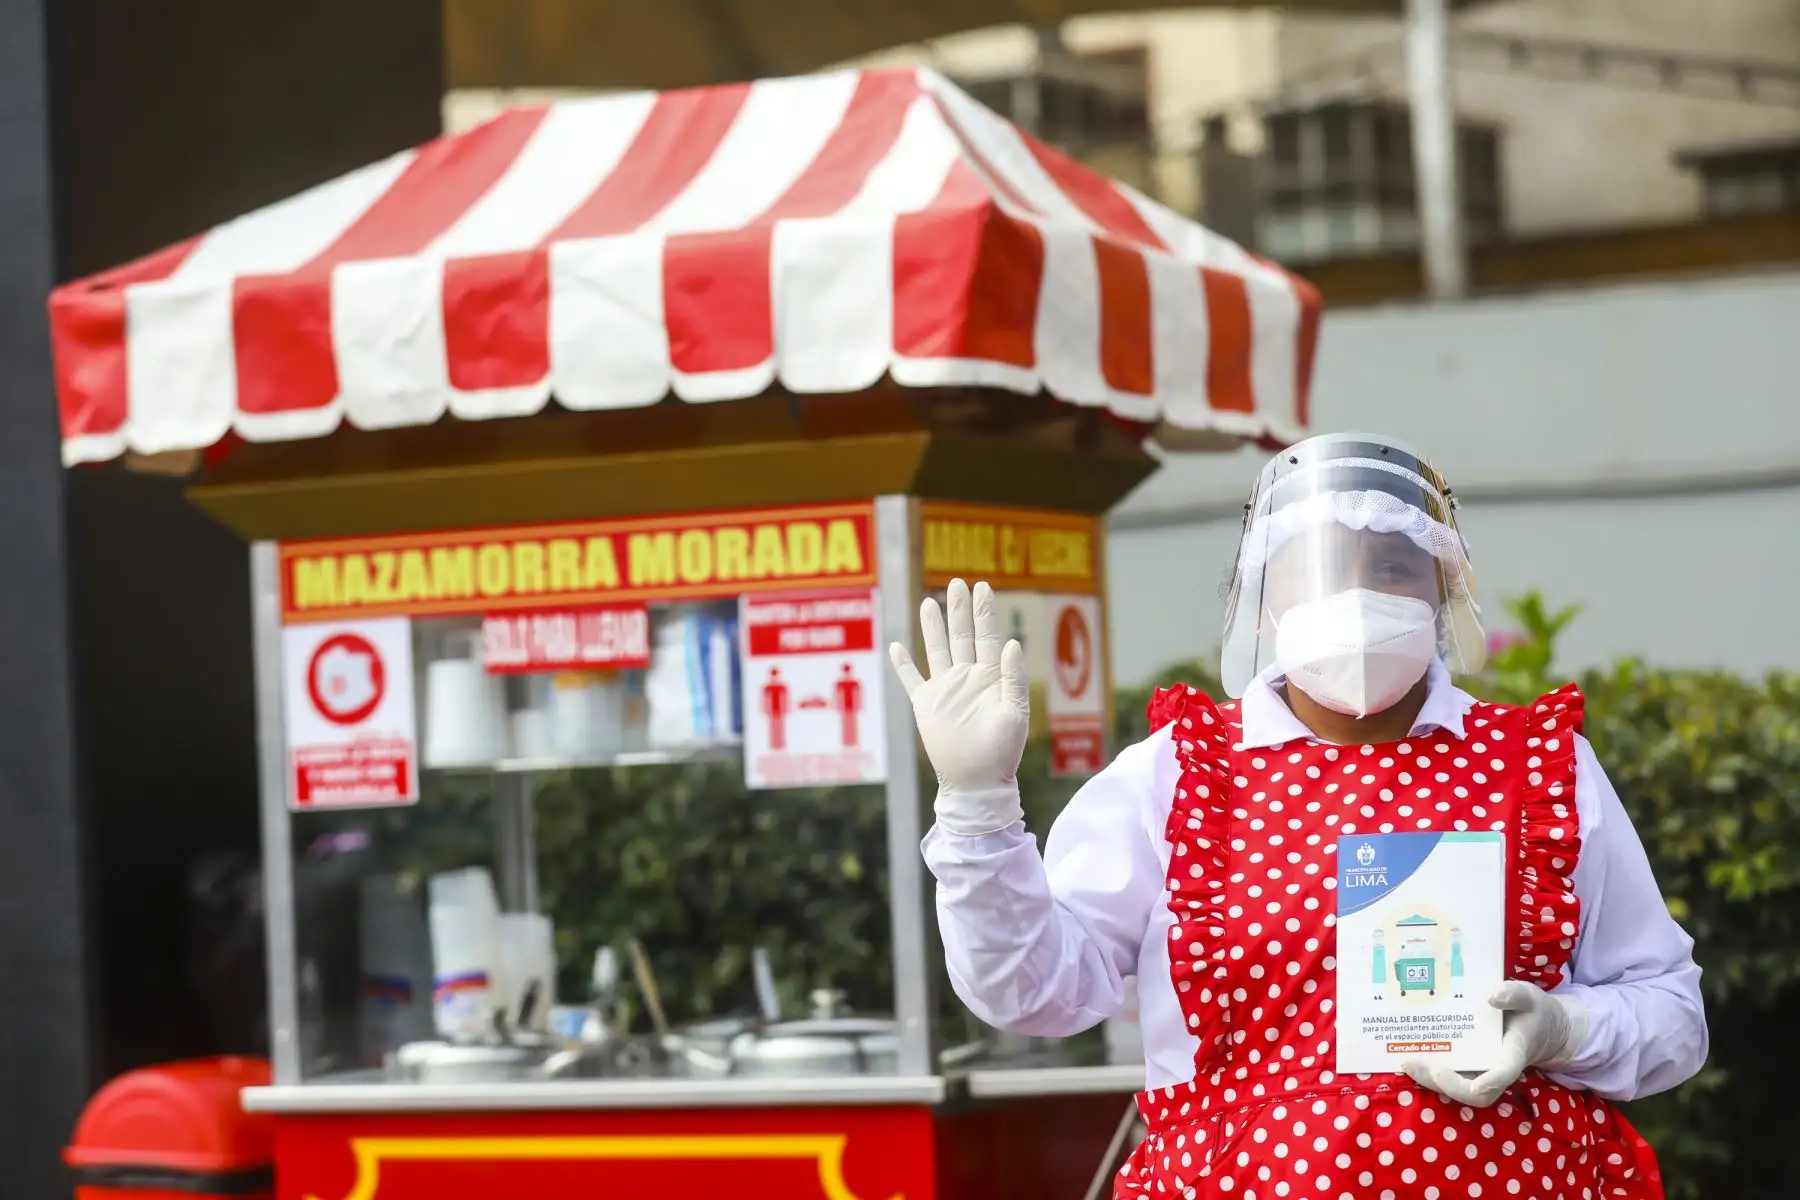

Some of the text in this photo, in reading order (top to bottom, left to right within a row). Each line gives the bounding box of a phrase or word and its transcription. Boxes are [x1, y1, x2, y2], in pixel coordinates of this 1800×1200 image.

[293, 518, 862, 609] MAZAMORRA MORADA
[1345, 874, 1389, 888] LIMA
[1362, 1014, 1475, 1024] MANUAL DE BIOSEGURIDAD
[1362, 1023, 1475, 1034] para comerciantes autorizados
[1394, 1033, 1421, 1041] espacio
[1422, 1031, 1450, 1041] público
[1451, 1031, 1463, 1039] del
[1388, 1043, 1450, 1052] Cercado de Lima
